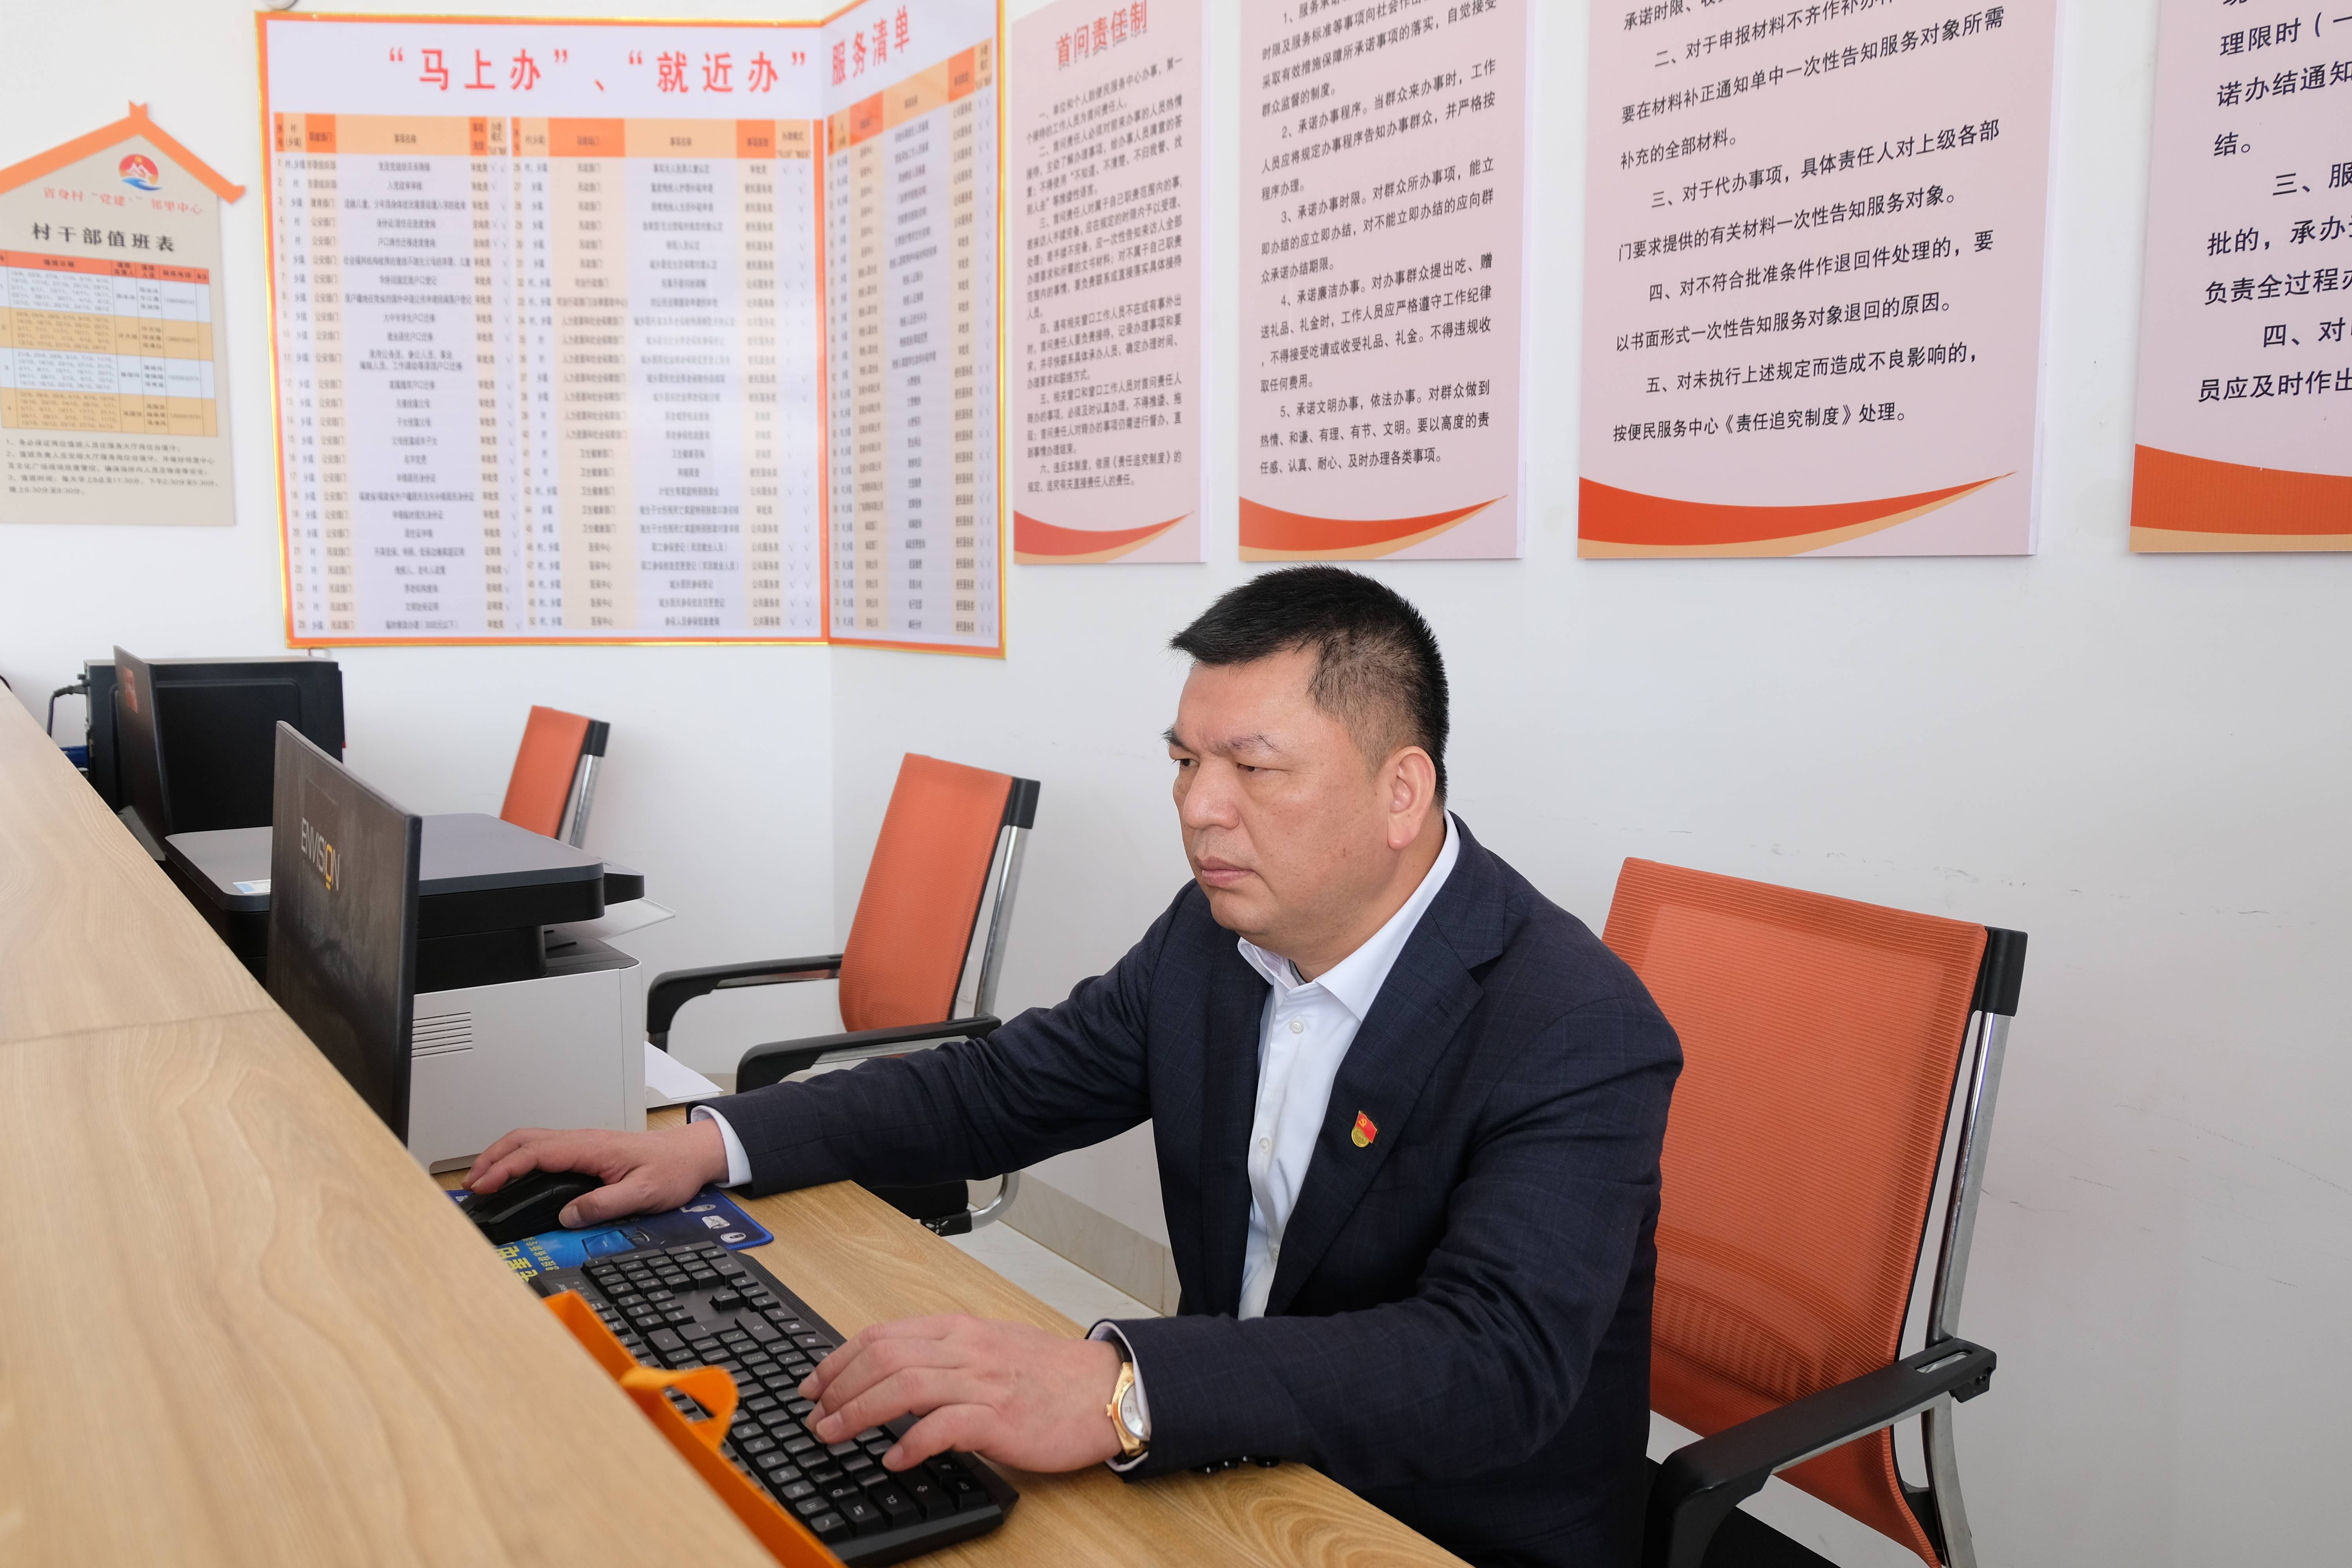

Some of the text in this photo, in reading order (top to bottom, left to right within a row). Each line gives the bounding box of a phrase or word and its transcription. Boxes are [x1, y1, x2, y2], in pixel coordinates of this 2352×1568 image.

[1055, 0, 1148, 69] 首问责任制
[1262, 0, 1431, 61] 时限及服务标准等事项向社会作
[1623, 0, 1724, 31] 承诺时限、
[1654, 0, 1893, 67] 二、对于申报材料不齐作补办
[832, 5, 911, 87] 服务清单
[1621, 5, 2004, 124] 要在材料补正通知单中一次性告知服务对象所需
[1261, 82, 1336, 118] 群众监督的制度。
[1281, 58, 1496, 139] 2、承诺办事程序。当群众来办事时，工作
[2216, 60, 2352, 107] 诺办结通知
[1261, 90, 1495, 174] 人员应将规定办事程序告知办事群众，并严格按
[1620, 127, 1736, 170] 补充的全部材料。
[2213, 131, 2251, 157] 结。
[1651, 118, 2000, 208] 三、对于代办事项，具体责任人对上级各部
[2272, 161, 2352, 196] 三、服
[1261, 178, 1304, 201] 程序办理。
[1281, 156, 1494, 223] 3、承诺办事时限。对群众所办事项，能立
[32, 222, 175, 252] 村干部值班表
[312, 217, 335, 227] 公安部门
[312, 236, 336, 246] 公安部门
[1261, 187, 1494, 256] 即办结的应立即办结，对不能立即办结的应向群
[1619, 184, 1955, 262] 门要求提供的有关材料一次性告知服务对象。
[2207, 215, 2352, 257] 批的，承办
[313, 255, 336, 265] 公安部门
[314, 274, 337, 284] 公安部门
[1261, 256, 1334, 285] 众承诺办结期限。
[1280, 251, 1493, 307] 4、承诺廉洁办事。对办事群众提出吃、赠
[1649, 229, 1994, 302] 四、对不符合批准条件作退回件处理的，要
[314, 293, 338, 303] 公安部门
[1027, 306, 1043, 321] 人员。
[1260, 283, 1492, 339] 送礼品、礼金时，工作人员应严格遵守工作纪律
[1261, 316, 1492, 367] ，不得接受吃请或收受礼品、礼金。不得违规收
[1616, 291, 1949, 352] 以书面形式一次性告知服务对象退回的原因。
[2263, 316, 2352, 348] 四、对
[1027, 368, 1091, 390] 办理要求和联络方式。
[1260, 373, 1313, 394] 取任何费用。
[1645, 341, 1976, 393] 五、对未执行上述规定而造成不良影响的，
[2198, 367, 2352, 403] 员应及时作出
[1280, 379, 1490, 418] 5、承诺文明办事，依法办事。对群众做到
[1260, 410, 1490, 448] 热情、和谦、有理、有节、文明。要以高度的责
[1612, 401, 1905, 443] 按便民服务中心《责任追究制度》处理。
[1027, 442, 1074, 459] 到事情办理结束。
[1260, 446, 1441, 475] 任感、认真、耐心、及时办理各类事项。
[301, 817, 340, 891] ENVISION
